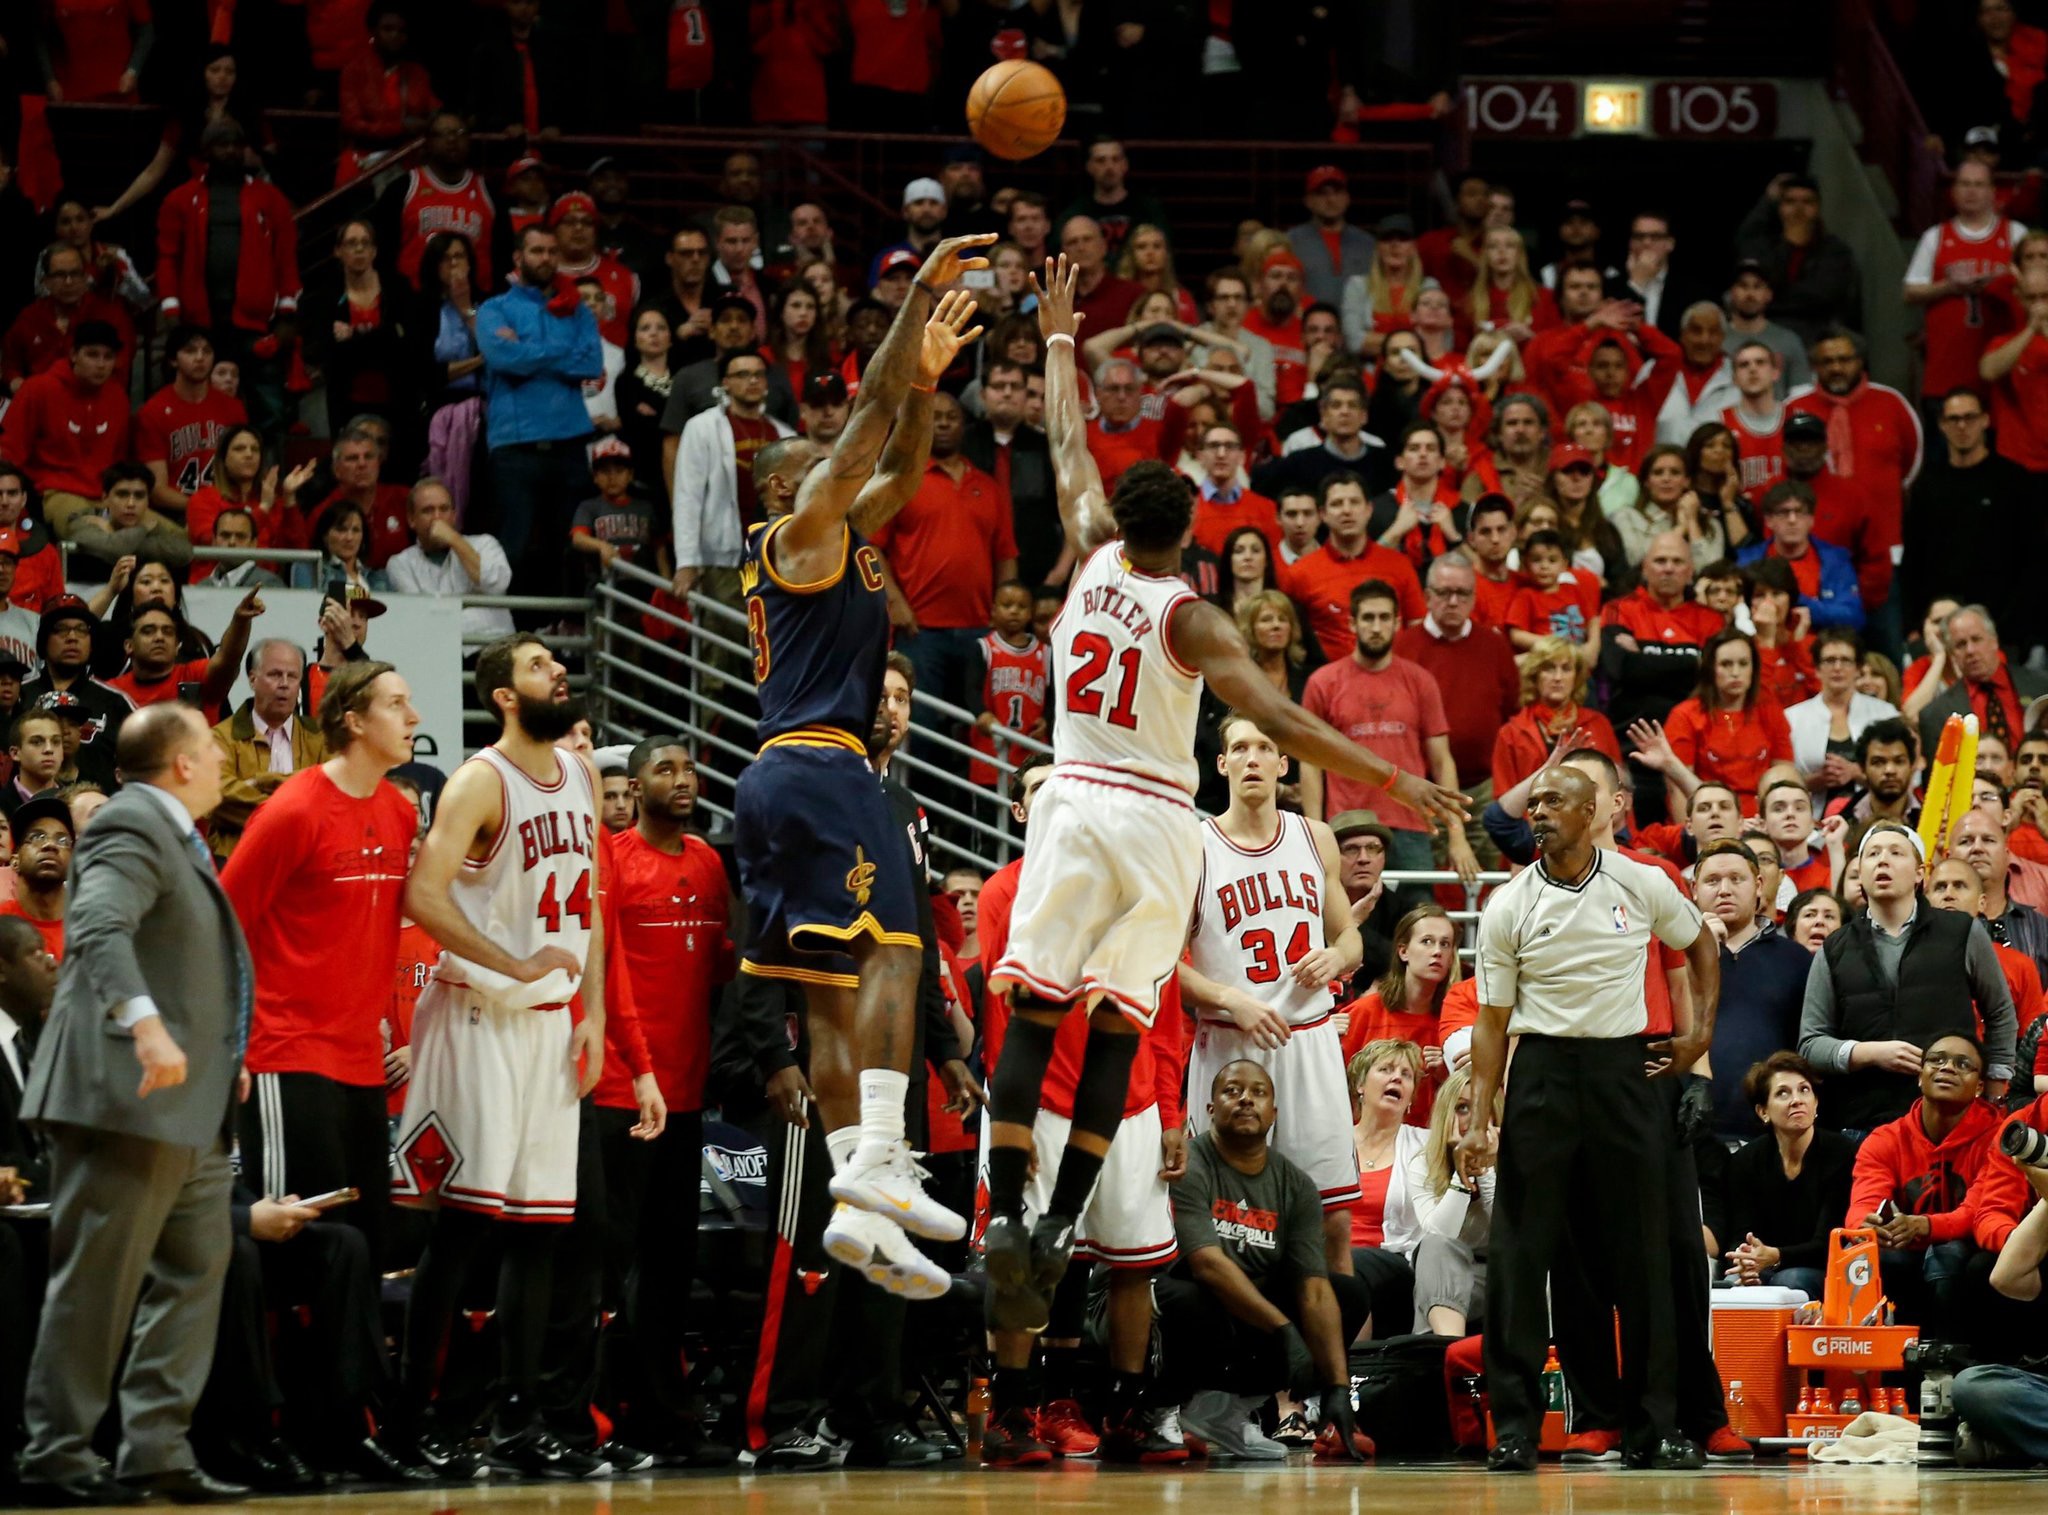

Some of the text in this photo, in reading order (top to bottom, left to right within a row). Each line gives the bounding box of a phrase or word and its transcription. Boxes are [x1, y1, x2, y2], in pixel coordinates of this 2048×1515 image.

[683, 8, 706, 45] 1
[1464, 84, 1560, 131] 104
[1666, 84, 1761, 132] 105
[1082, 584, 1153, 642] BUTLER
[1066, 629, 1142, 731] 21
[1006, 694, 1024, 730] 1
[518, 810, 593, 873] BULLS
[537, 868, 592, 933] 44
[1216, 869, 1320, 934] BULLS
[1240, 921, 1311, 985] 34
[1812, 1336, 1873, 1356] G PRIME
